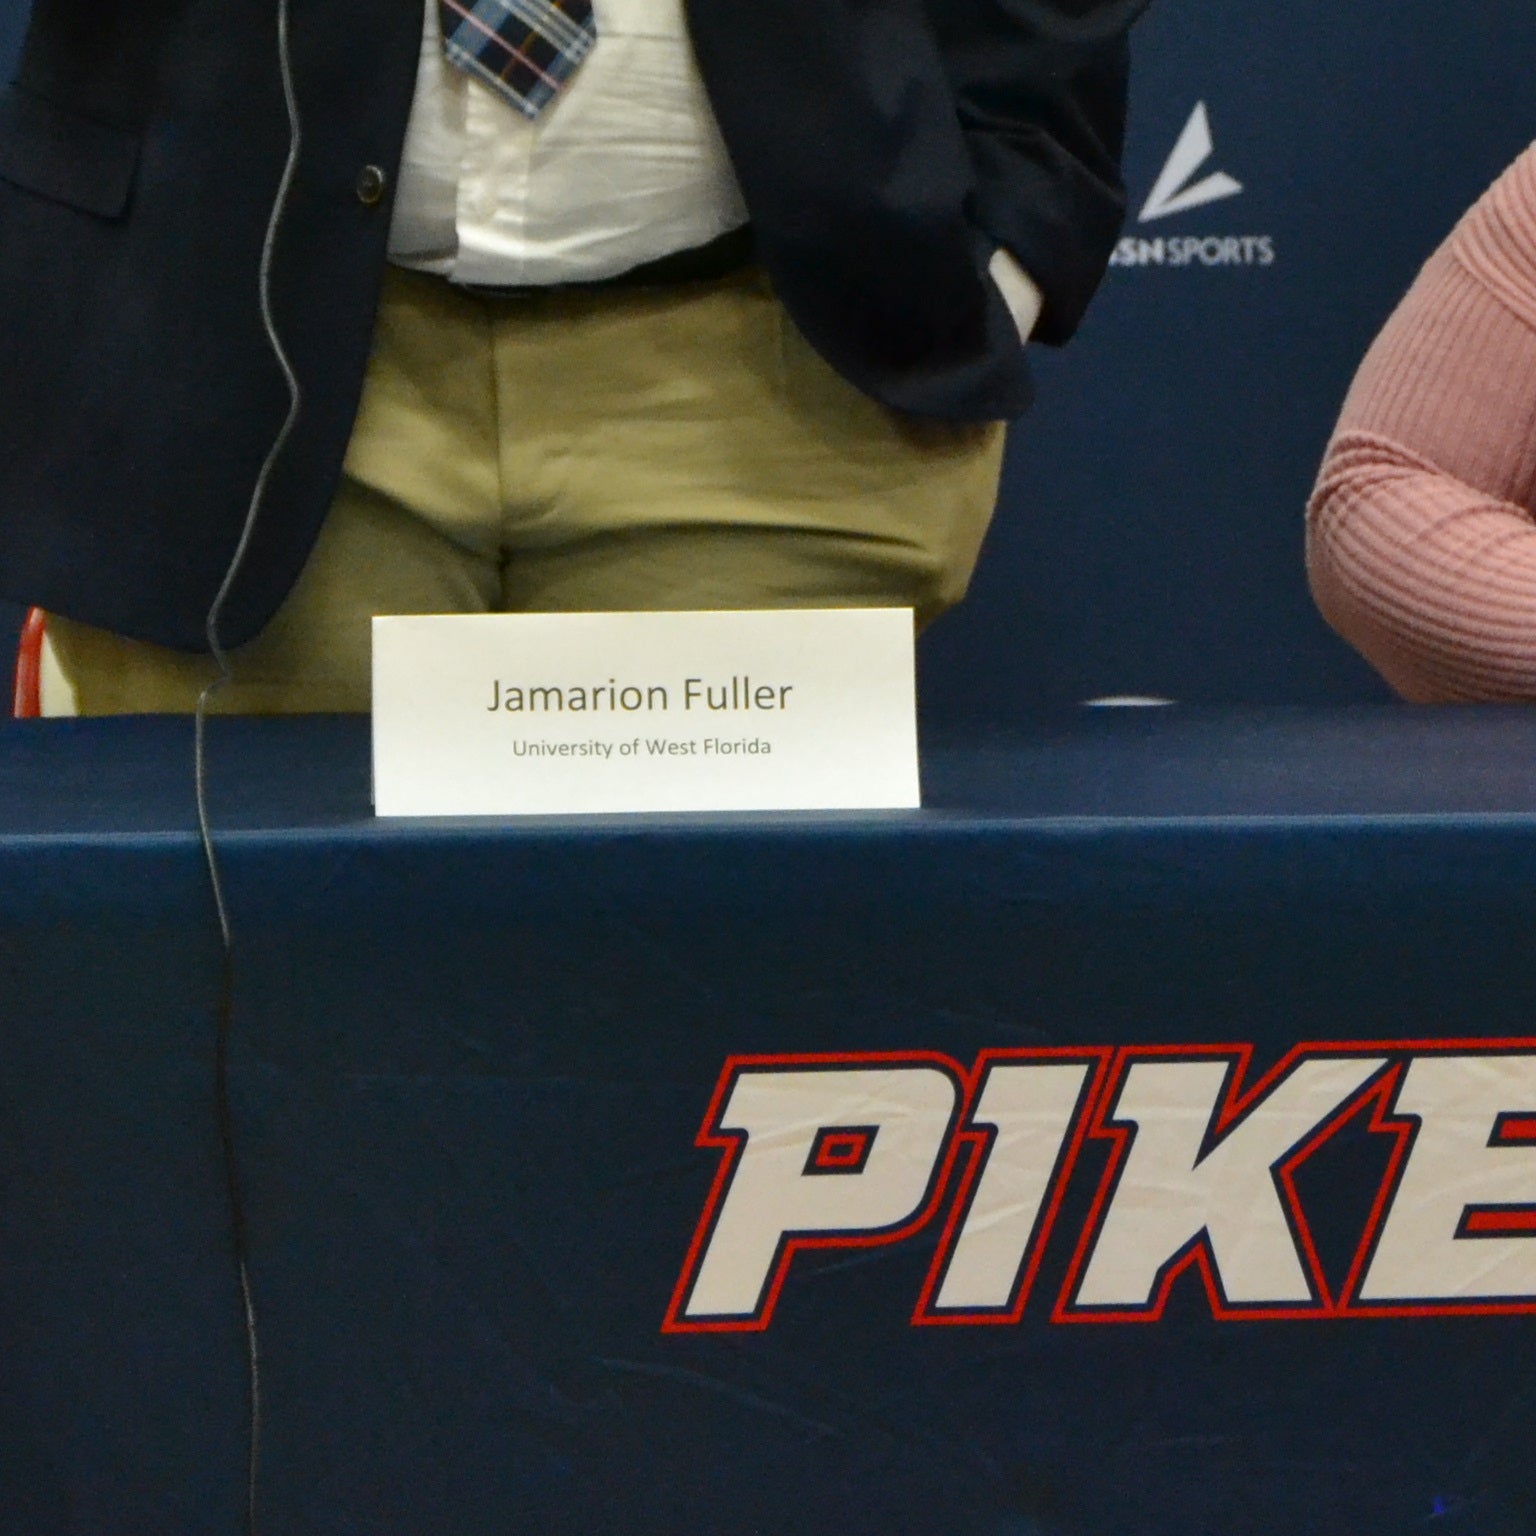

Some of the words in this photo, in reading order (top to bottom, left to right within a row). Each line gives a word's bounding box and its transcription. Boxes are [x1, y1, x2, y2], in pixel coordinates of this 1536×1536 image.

[486, 677, 669, 713] Jamarion
[683, 674, 794, 712] Fuller
[511, 738, 615, 760] University
[618, 736, 641, 757] of
[644, 737, 698, 757] West
[702, 736, 773, 757] Florida
